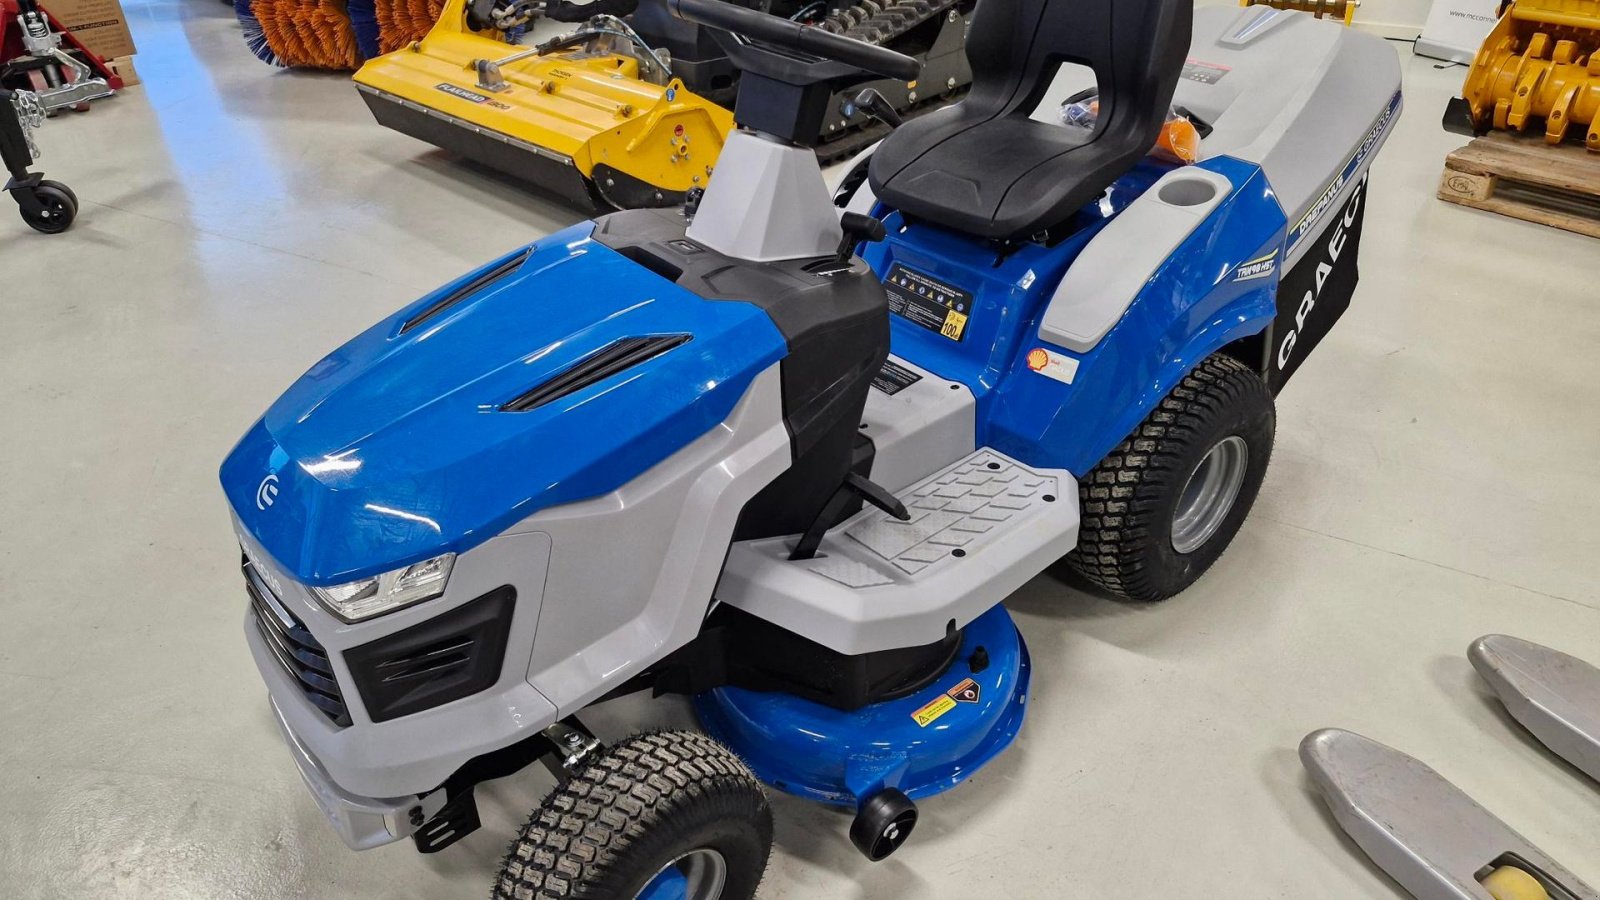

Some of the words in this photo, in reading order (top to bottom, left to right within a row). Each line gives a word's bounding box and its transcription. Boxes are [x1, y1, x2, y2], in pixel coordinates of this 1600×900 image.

[1449, 10, 1496, 23] www.mcconne
[439, 83, 486, 103] FLAILHEAD
[1299, 174, 1345, 235] DREPANUS
[943, 322, 957, 337] 100
